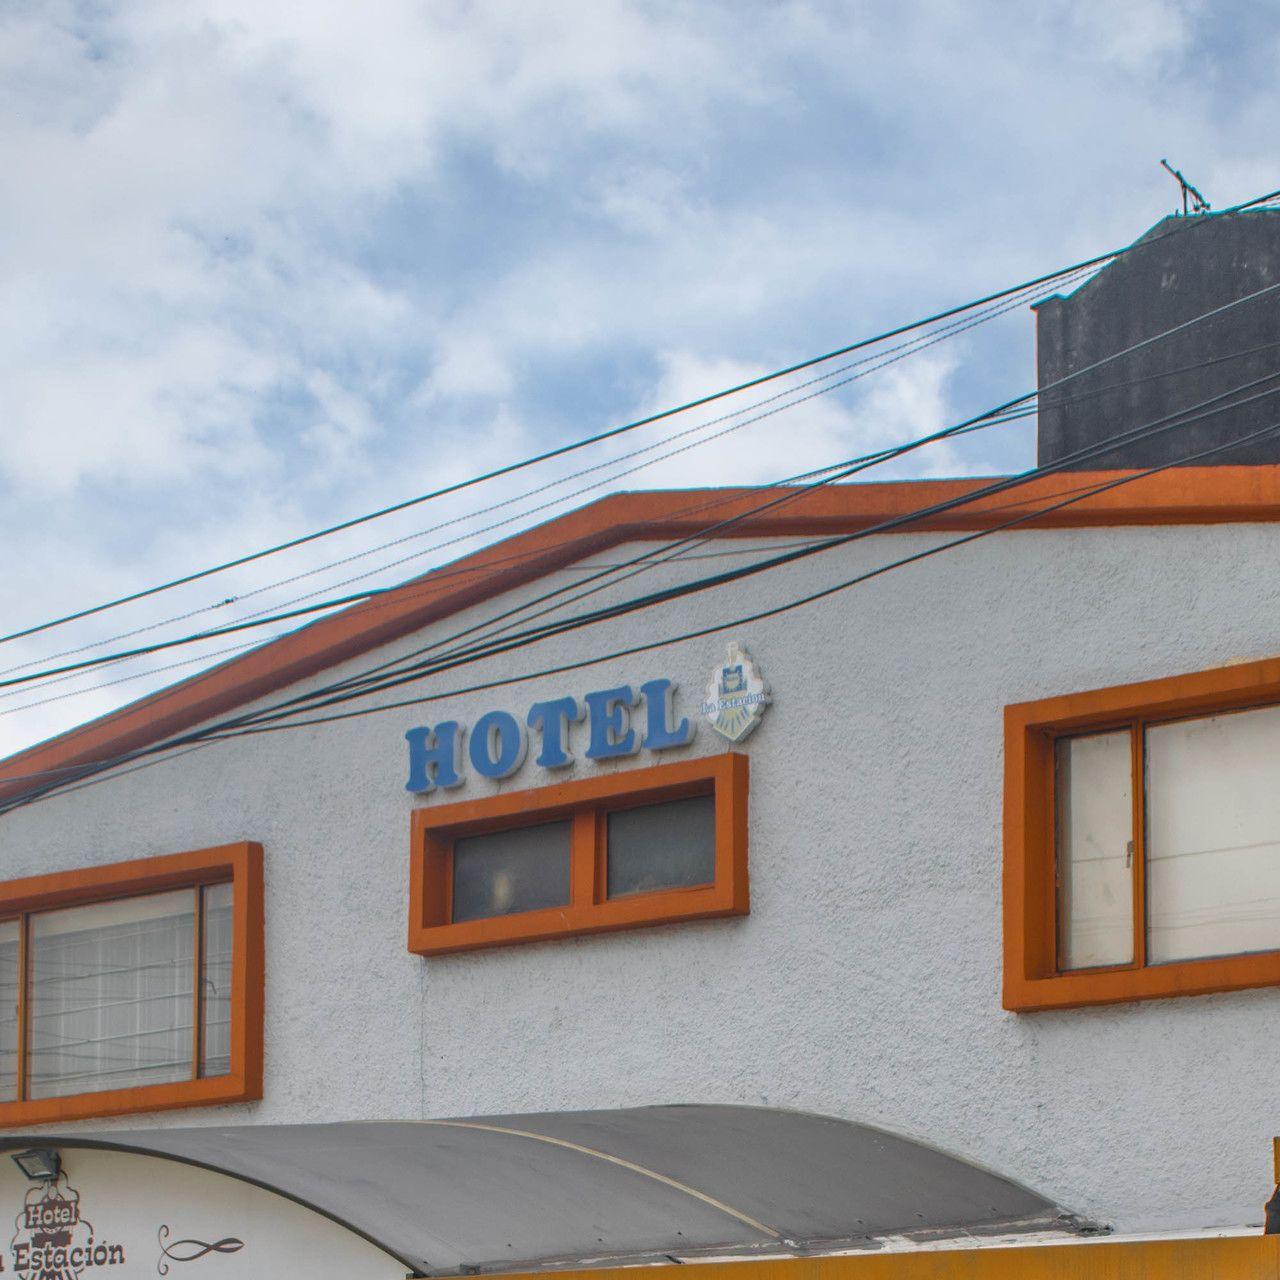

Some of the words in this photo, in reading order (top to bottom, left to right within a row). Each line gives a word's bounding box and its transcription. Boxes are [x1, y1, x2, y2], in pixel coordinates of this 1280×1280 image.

[405, 678, 692, 794] HOTEL
[27, 1201, 78, 1226] Hotel
[14, 1238, 125, 1272] Estación
